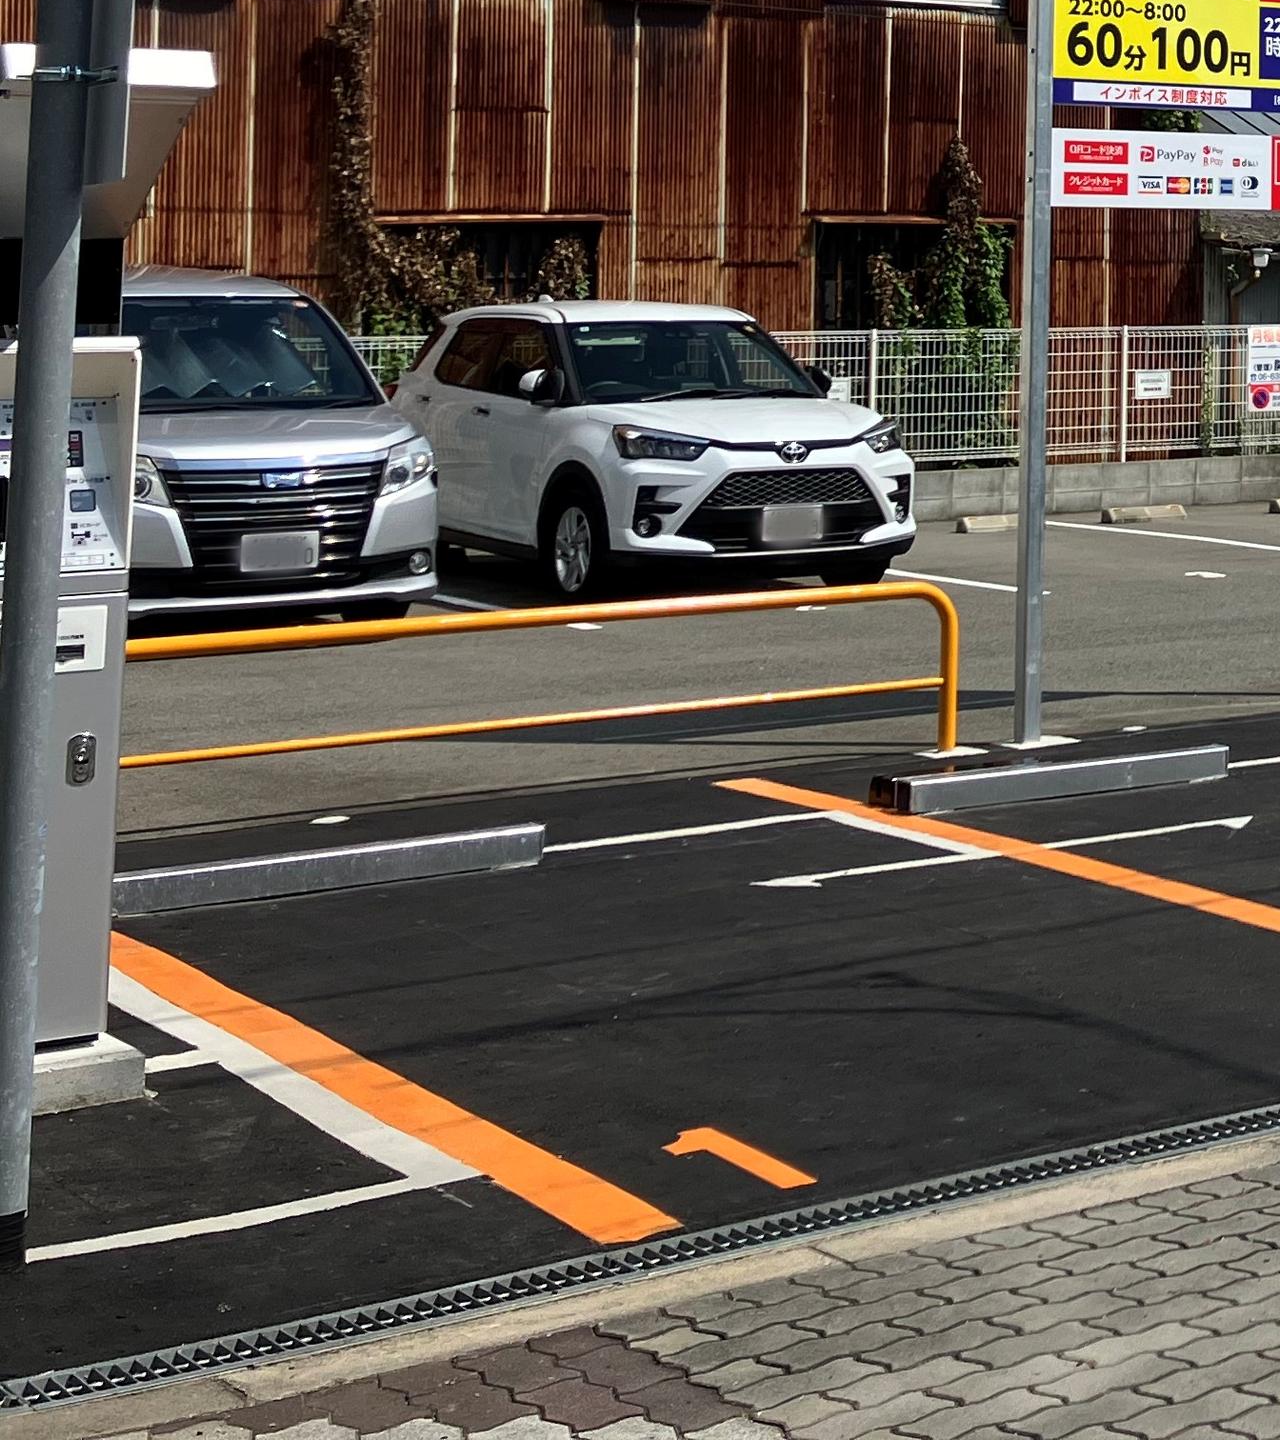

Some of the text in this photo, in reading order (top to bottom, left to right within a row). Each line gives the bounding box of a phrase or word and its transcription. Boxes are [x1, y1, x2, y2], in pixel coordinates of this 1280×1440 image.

[1067, 21, 1251, 77] 60分100円
[1100, 86, 1228, 106] インボイス制度対応
[1157, 148, 1197, 163] PayPay
[1069, 176, 1124, 187] クレジットカード
[1142, 181, 1161, 190] VISA
[661, 1127, 818, 1189] 1
